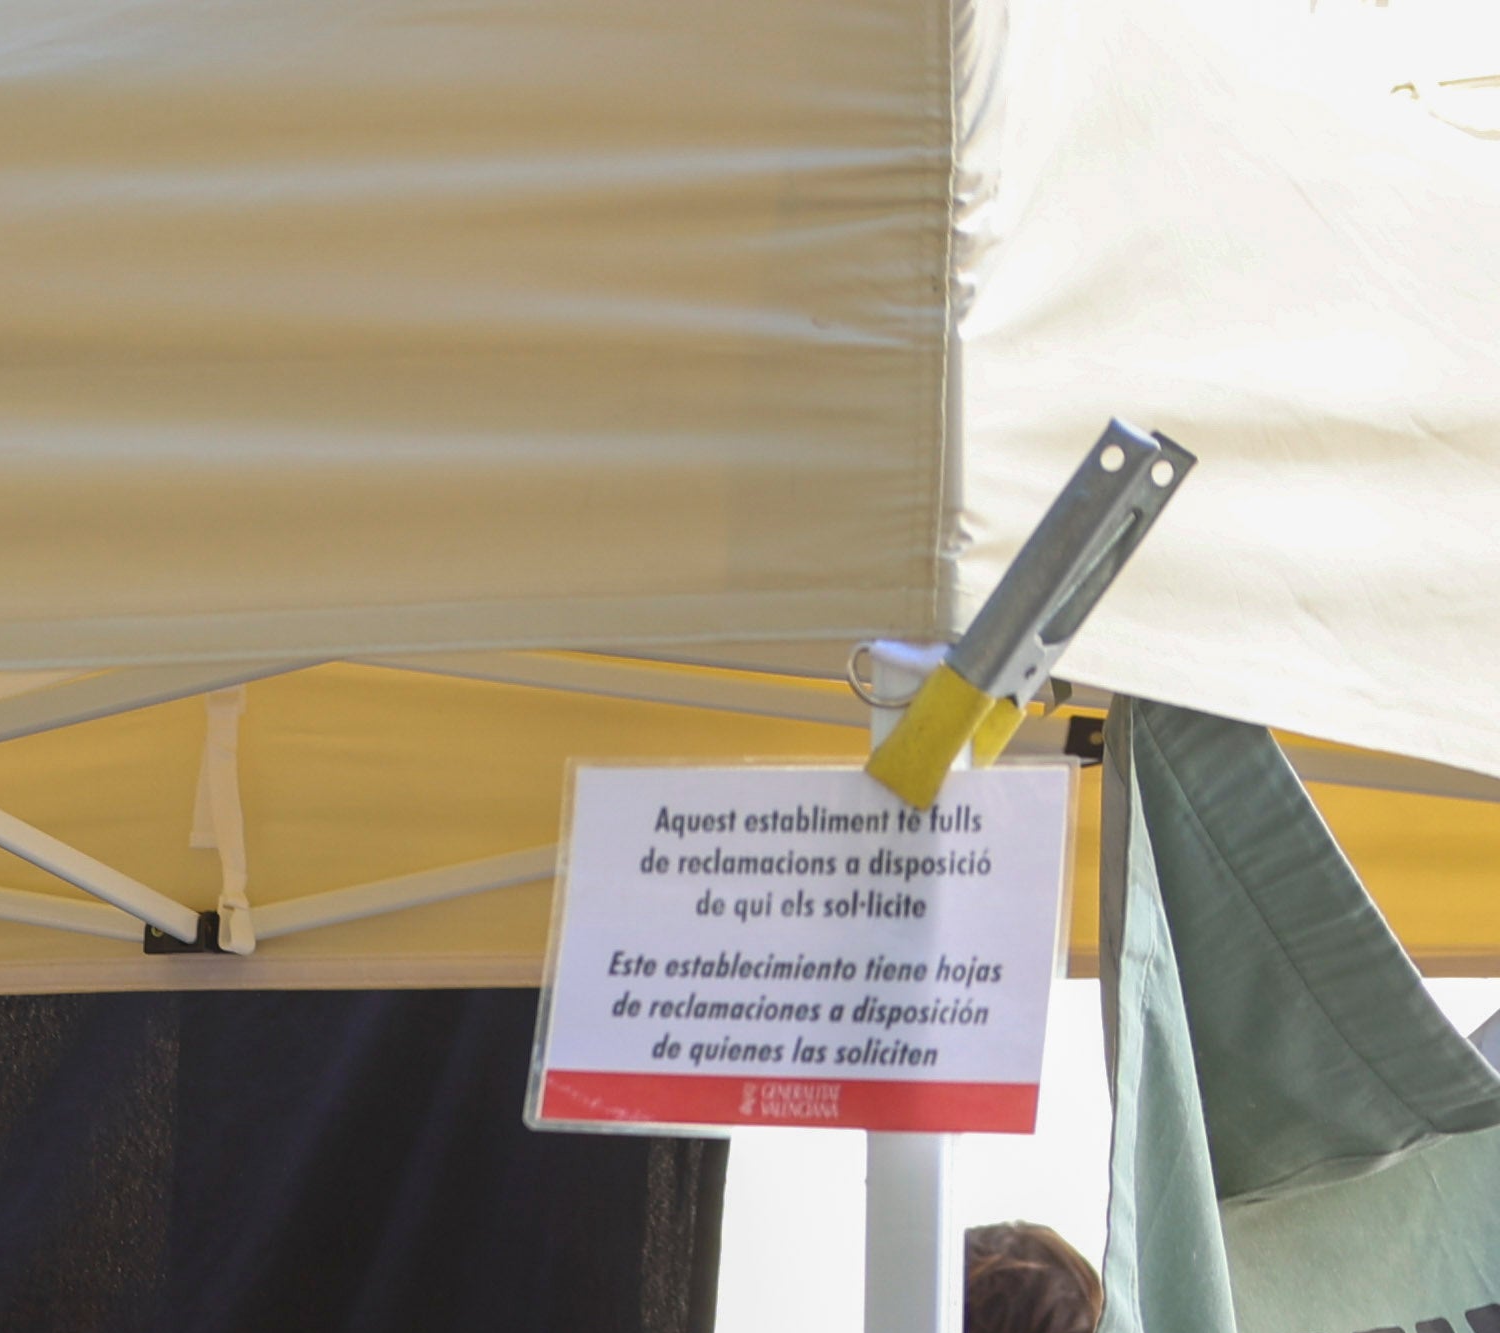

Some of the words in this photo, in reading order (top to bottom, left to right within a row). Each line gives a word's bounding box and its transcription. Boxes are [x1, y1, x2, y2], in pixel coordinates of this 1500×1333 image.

[655, 806, 736, 836] Aquest
[745, 807, 890, 834] establiment
[929, 806, 982, 834] fulls
[640, 847, 669, 874] de
[678, 847, 837, 877] reclamacions
[845, 855, 860, 876] a
[869, 847, 992, 883] disposició
[696, 890, 726, 917] de
[734, 892, 772, 924] qui
[781, 892, 815, 918] els
[823, 890, 927, 919] sol·licite
[609, 952, 656, 978] Este
[666, 954, 857, 982] establecimiento
[866, 956, 927, 983] tiene
[936, 957, 1003, 989] hojas
[612, 993, 641, 1020] de
[649, 994, 820, 1024] reclamaciones
[829, 1004, 843, 1023] a
[852, 999, 989, 1032] disposición
[652, 1035, 681, 1060] de
[689, 1039, 785, 1070] quienes
[793, 1038, 826, 1065] las
[835, 1040, 938, 1067] soliciten
